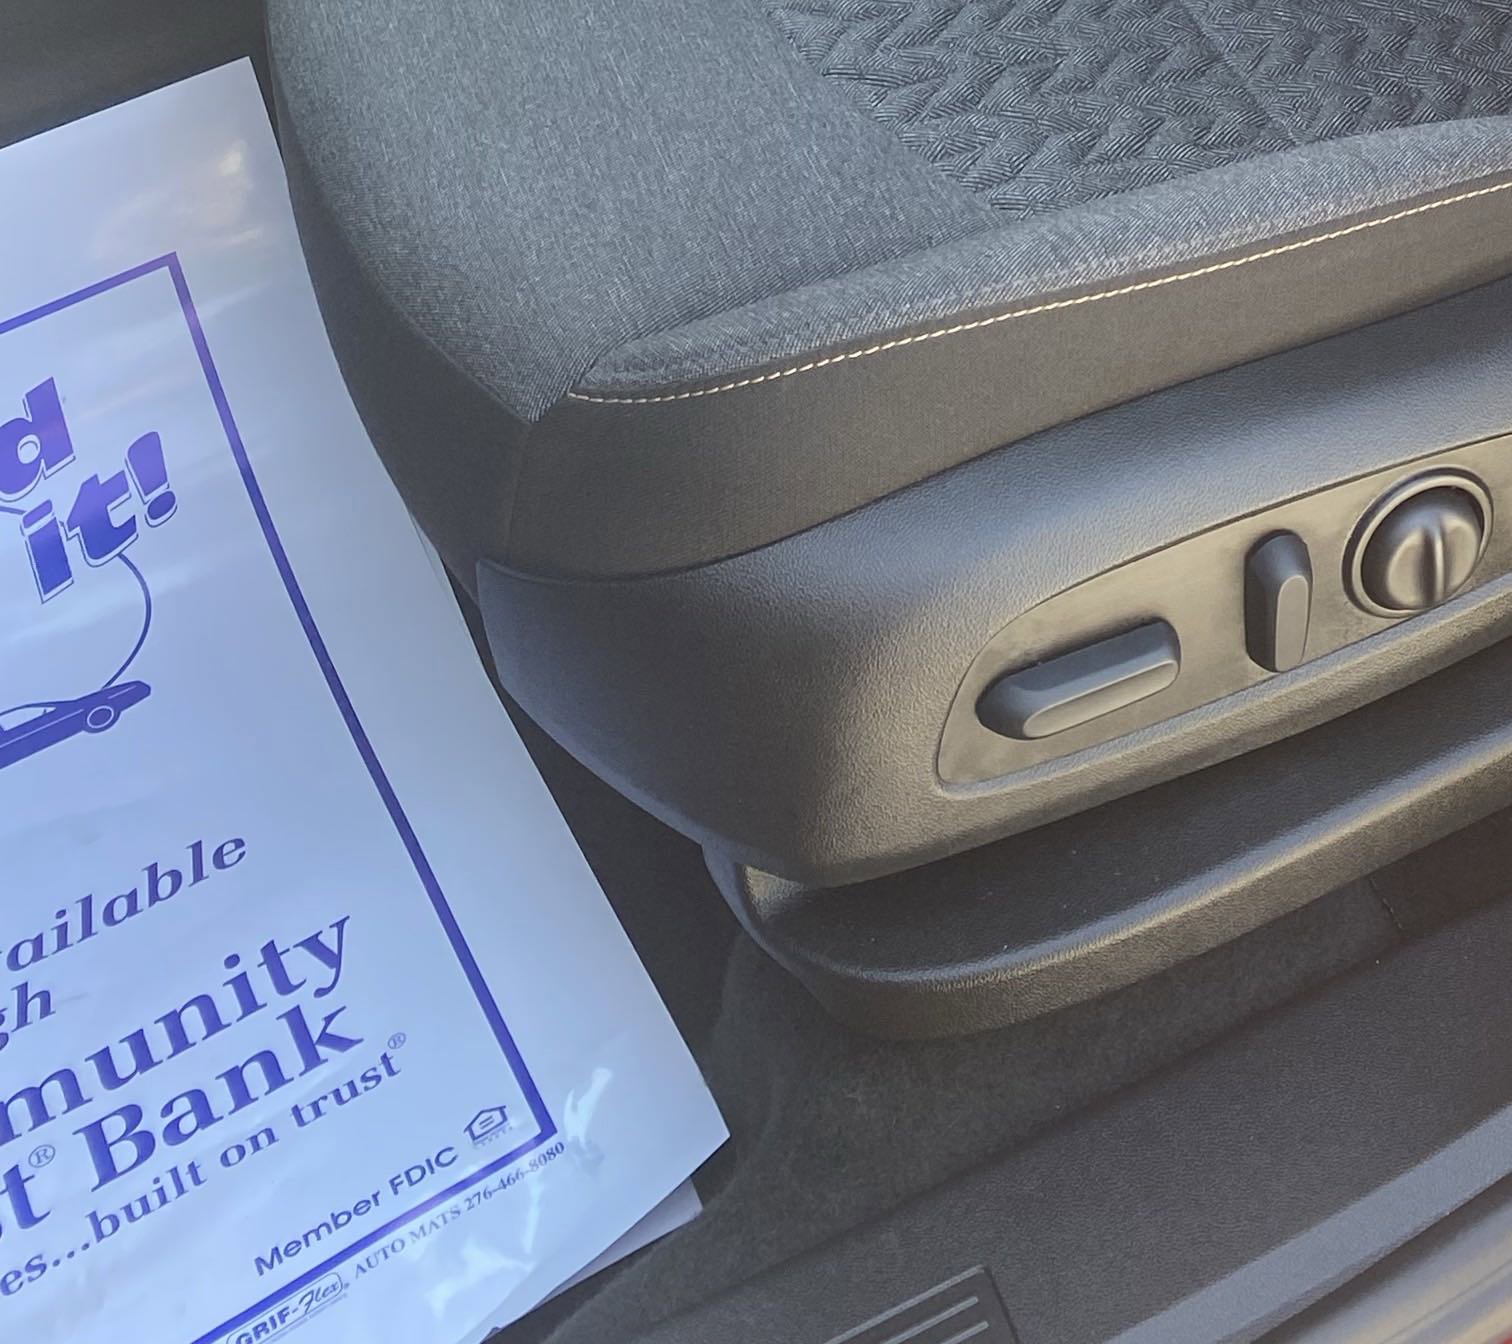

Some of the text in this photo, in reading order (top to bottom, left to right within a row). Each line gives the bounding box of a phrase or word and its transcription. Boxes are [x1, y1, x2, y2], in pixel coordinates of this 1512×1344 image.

[13, 431, 178, 605] it!
[0, 838, 247, 972] ailable
[0, 915, 350, 1147] munity
[72, 1004, 364, 1193] Bank
[220, 1126, 279, 1168] on
[254, 1146, 459, 1276] Member FDIC
[354, 1238, 406, 1279] AUTO
[409, 1204, 462, 1245] MATS
[464, 1141, 565, 1212] 276-466-8080
